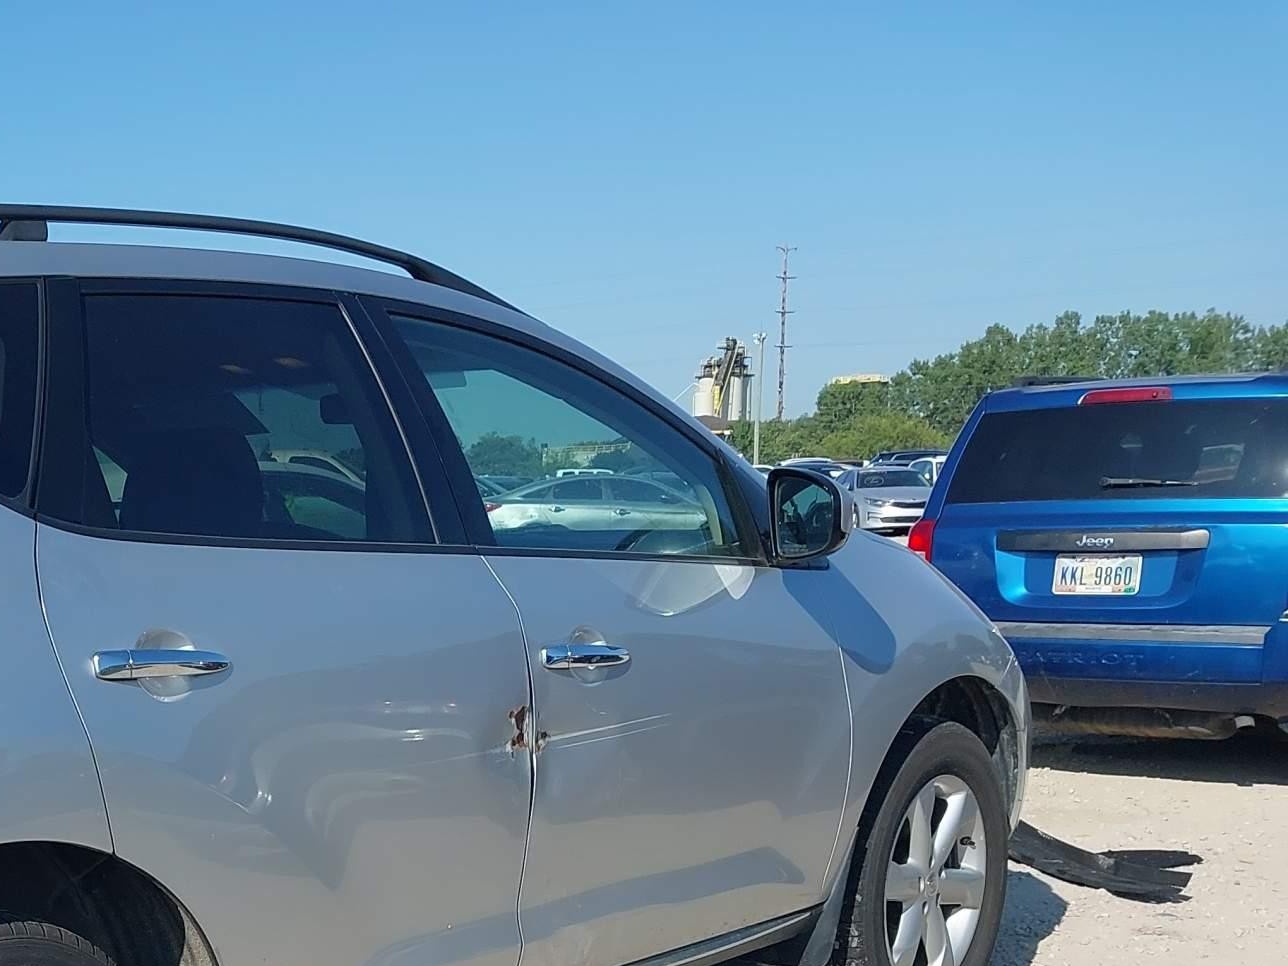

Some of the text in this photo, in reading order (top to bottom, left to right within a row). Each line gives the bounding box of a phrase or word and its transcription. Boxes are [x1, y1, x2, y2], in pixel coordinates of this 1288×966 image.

[1075, 534, 1114, 549] Jeep
[1060, 566, 1133, 585] KKL 9860
